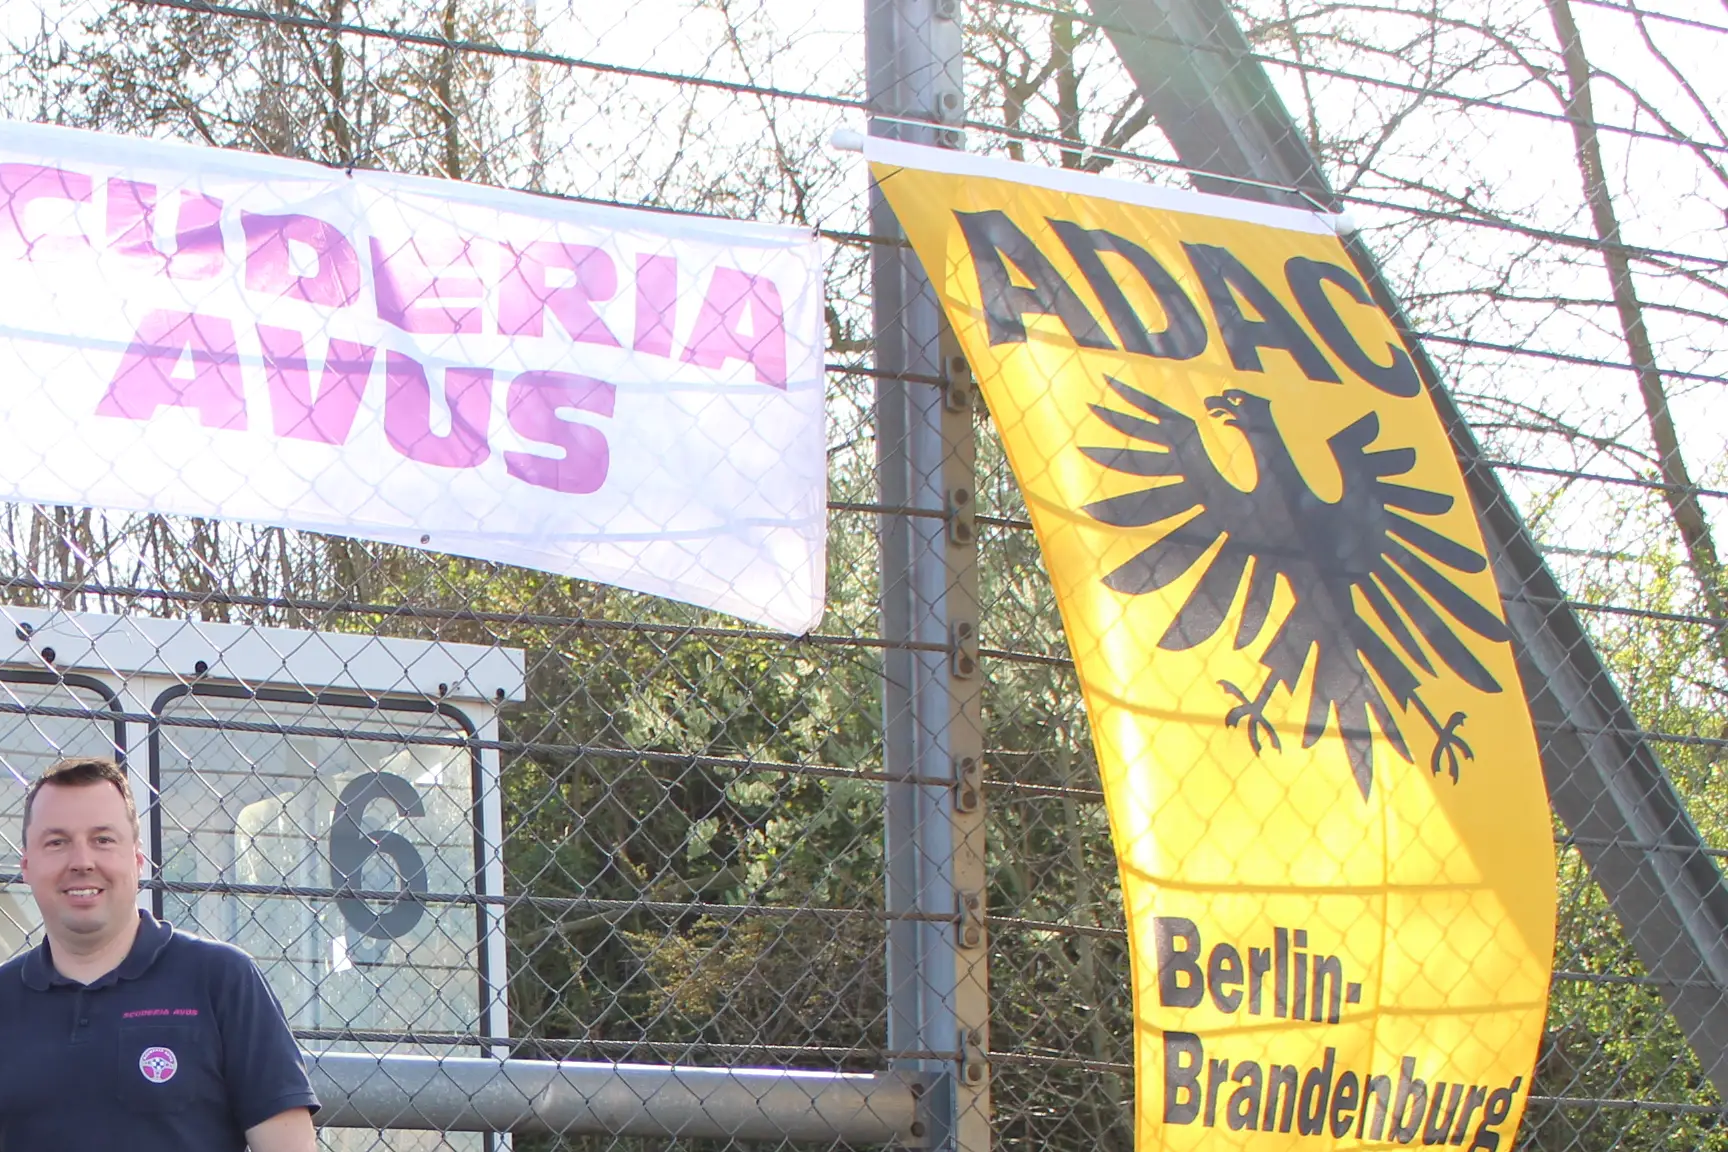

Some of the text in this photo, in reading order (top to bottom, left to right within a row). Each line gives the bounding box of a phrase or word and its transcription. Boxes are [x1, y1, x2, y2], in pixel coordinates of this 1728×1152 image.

[952, 207, 1421, 399] ADAC
[94, 307, 617, 495] AVUS
[329, 770, 429, 941] 6
[1152, 915, 1363, 1025] Berlin-
